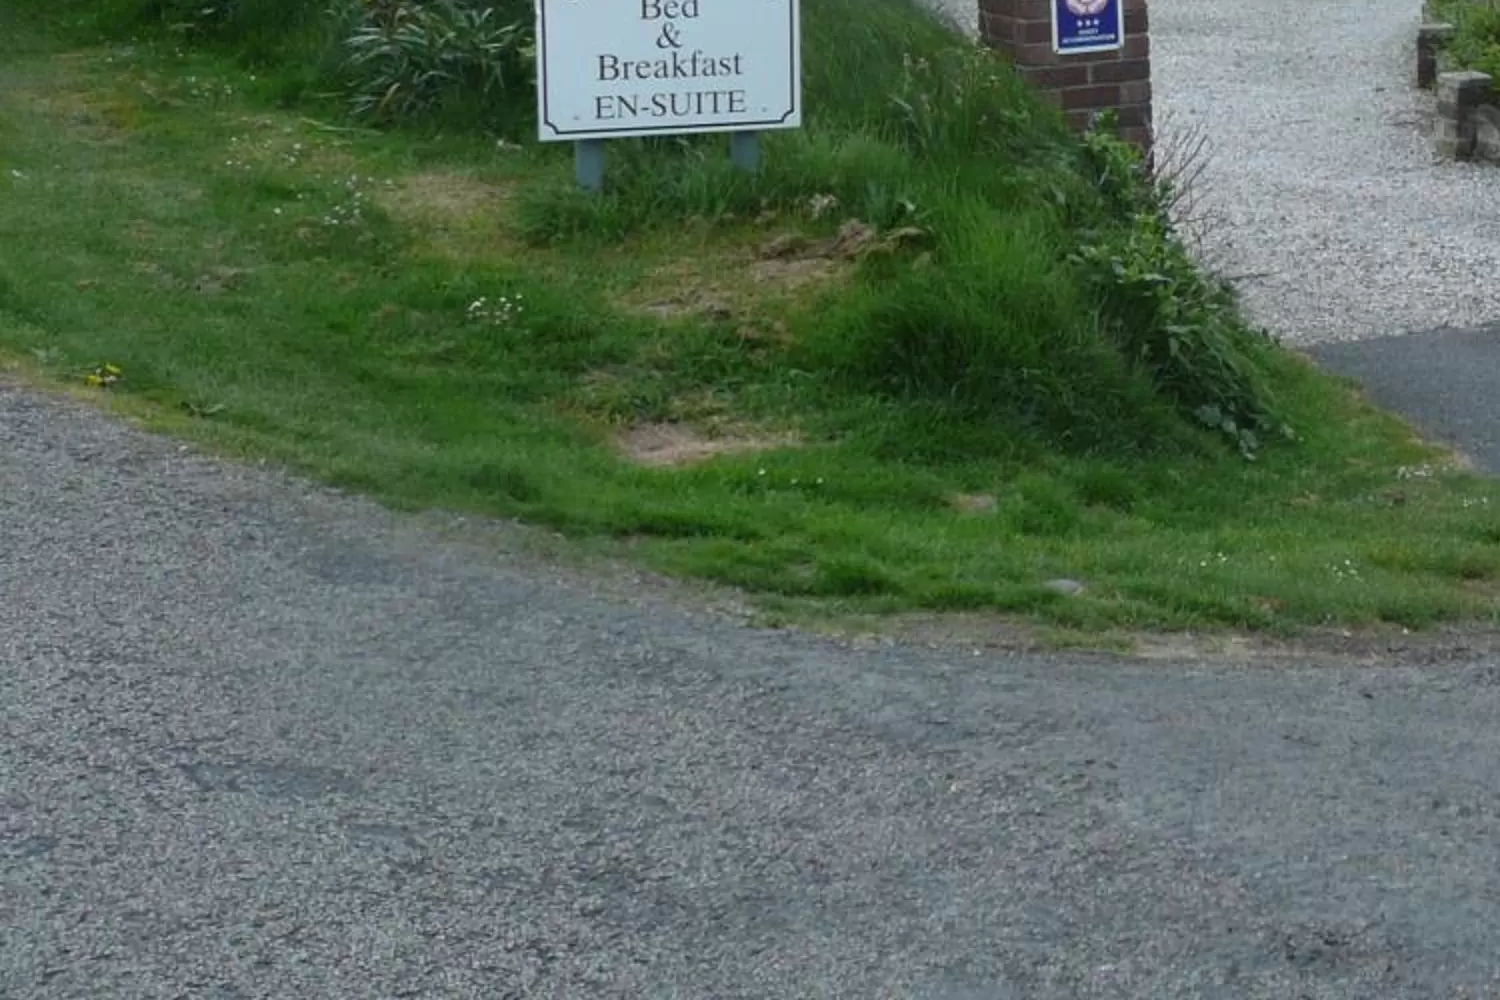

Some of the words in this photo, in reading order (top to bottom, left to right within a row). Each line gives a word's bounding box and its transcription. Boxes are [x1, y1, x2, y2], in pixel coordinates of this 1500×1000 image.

[656, 21, 683, 49] &
[596, 50, 744, 81] Breakfast
[595, 89, 747, 120] EN-SUITE
